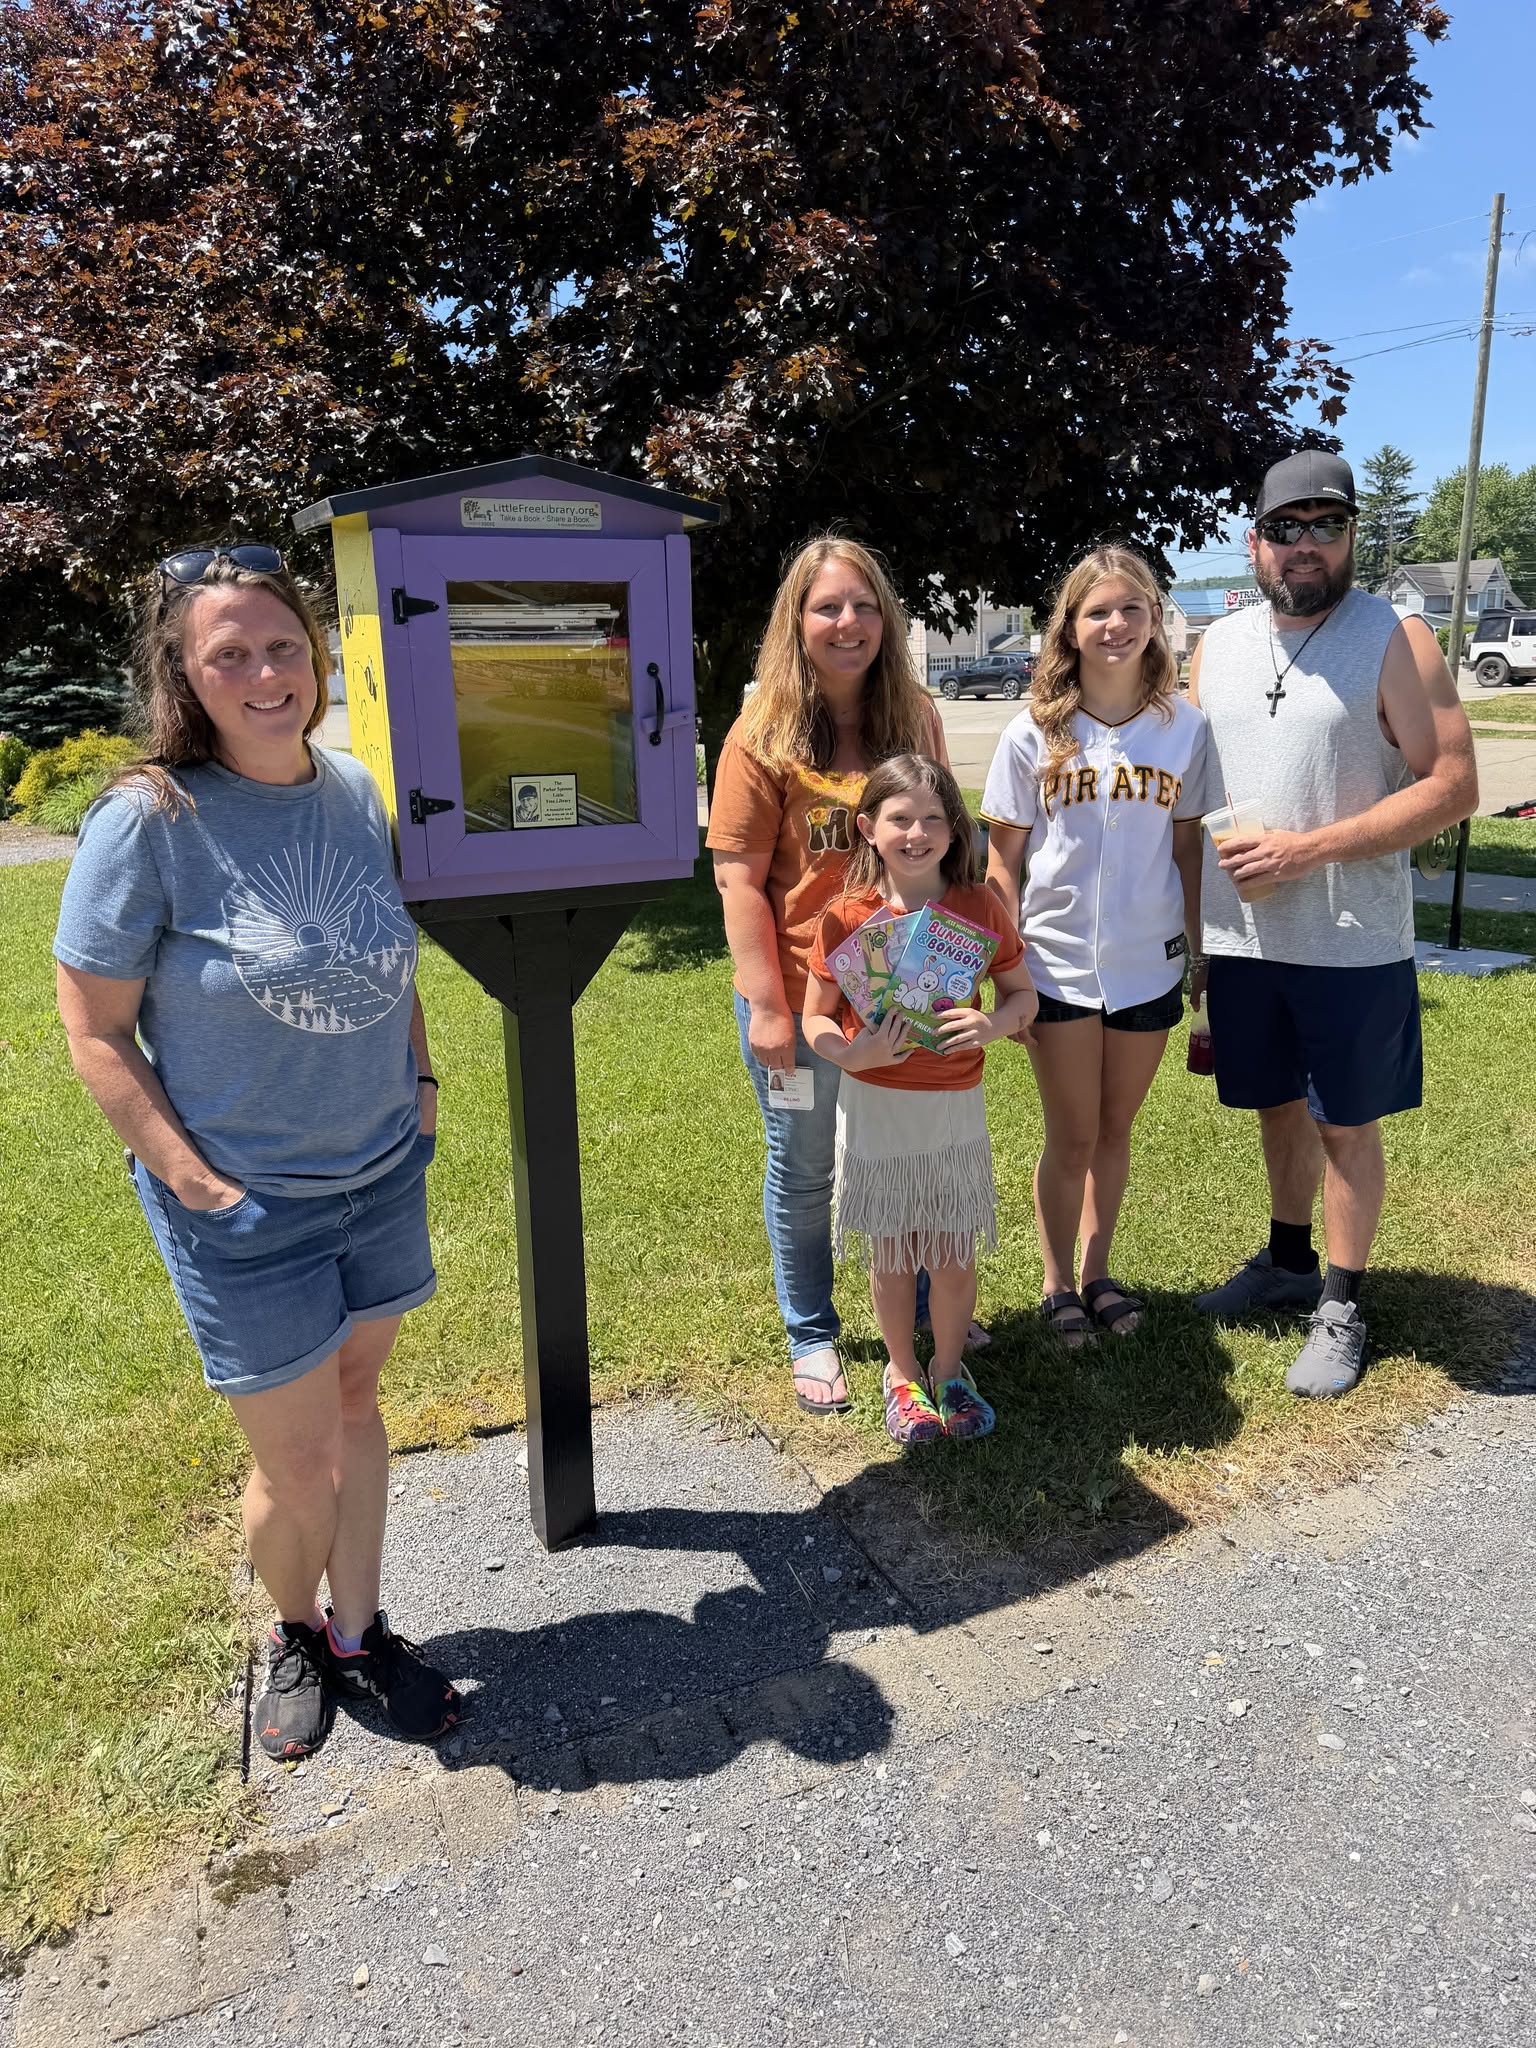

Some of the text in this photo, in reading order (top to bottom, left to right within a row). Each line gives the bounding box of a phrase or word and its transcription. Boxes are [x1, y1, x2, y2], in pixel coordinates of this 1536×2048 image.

[493, 503, 594, 517] LittleFreeLibrary.org
[500, 514, 515, 522] Take
[546, 515, 567, 523] Share
[927, 920, 984, 955] BUNBUN
[915, 931, 985, 971] & BONBON
[913, 1020, 933, 1034] FRIEN
